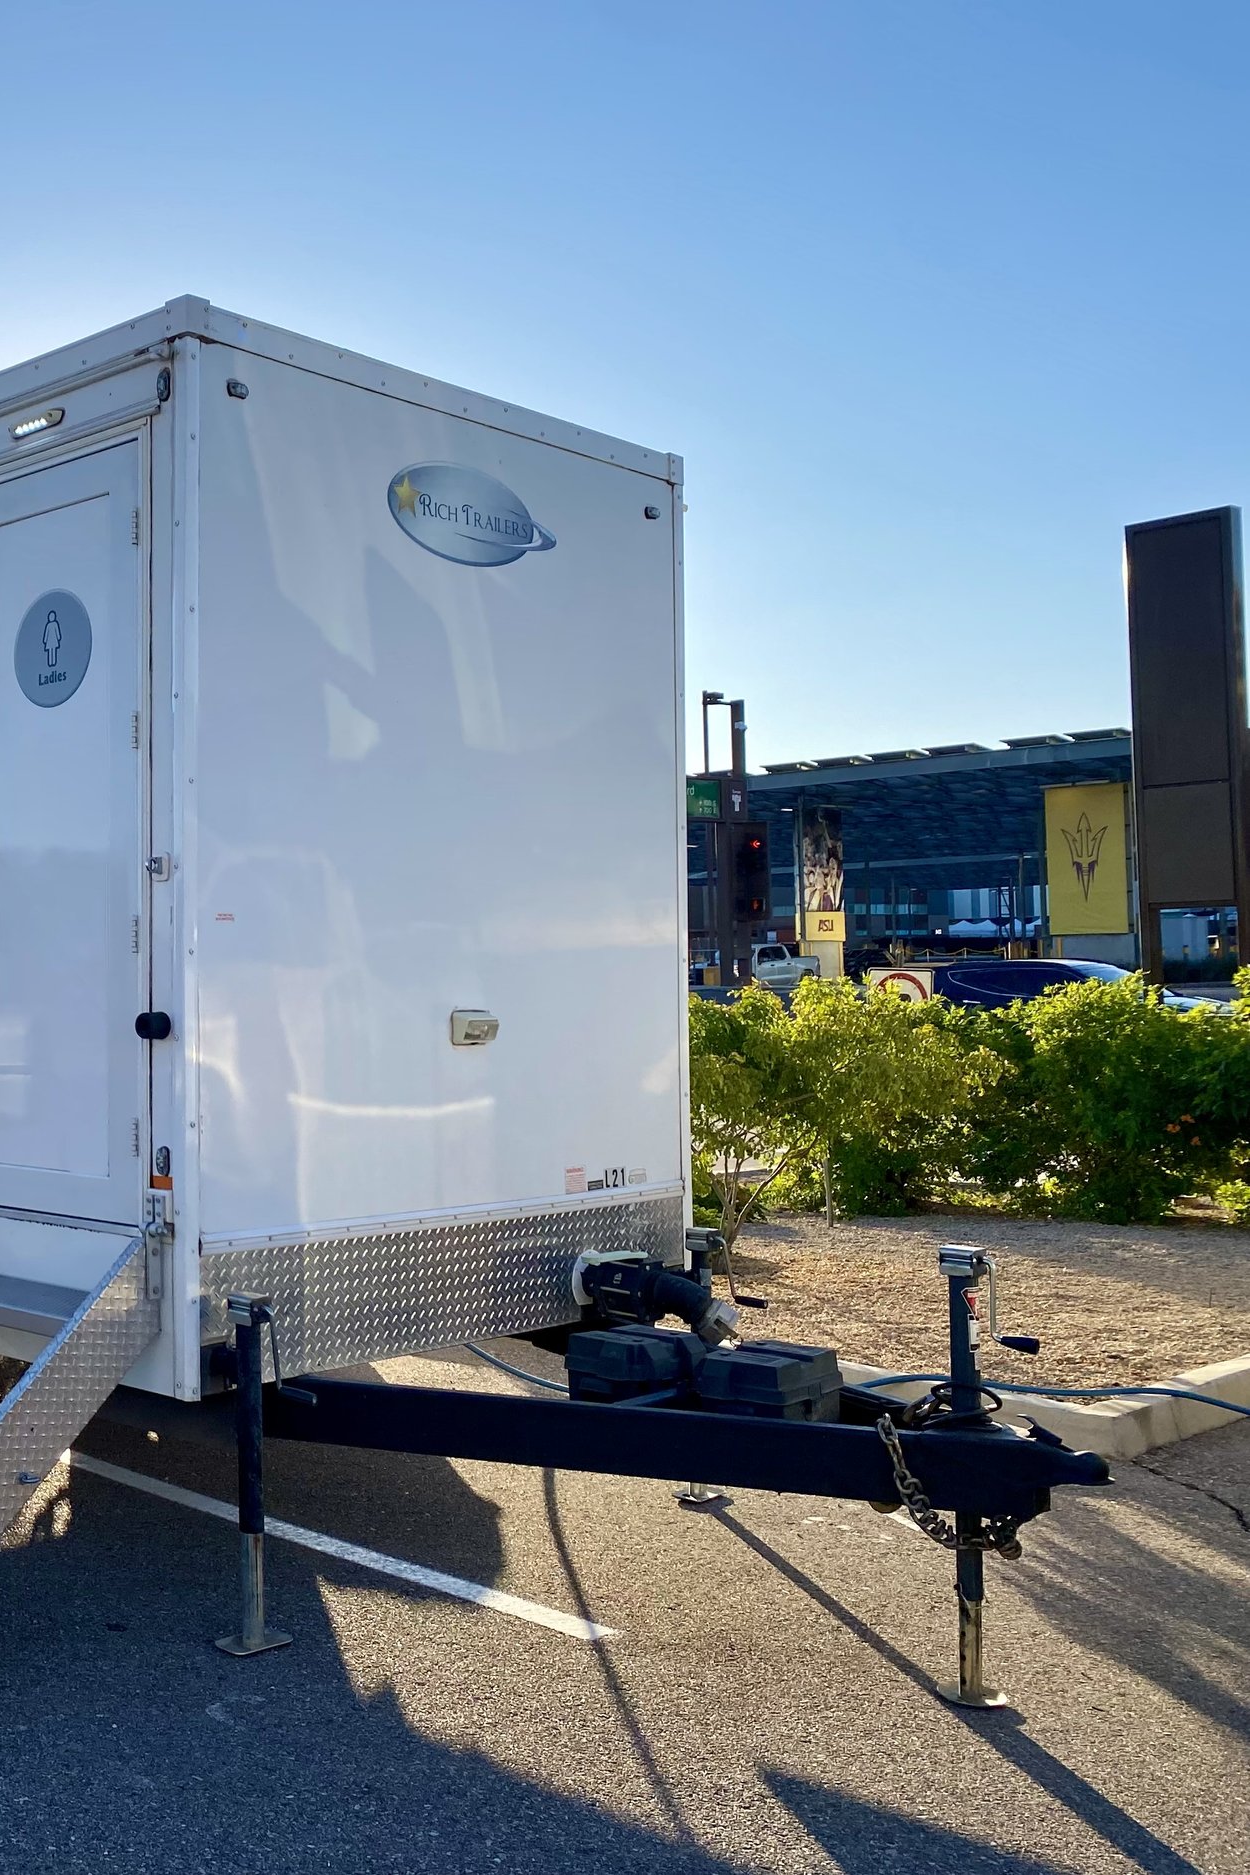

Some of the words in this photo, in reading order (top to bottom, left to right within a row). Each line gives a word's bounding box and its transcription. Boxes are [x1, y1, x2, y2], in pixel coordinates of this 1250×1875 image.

[418, 493, 458, 523] RICH
[461, 503, 529, 539] TRAILERS
[38, 670, 67, 686] Ladies
[817, 919, 834, 932] ASU
[605, 1167, 625, 1188] L21
